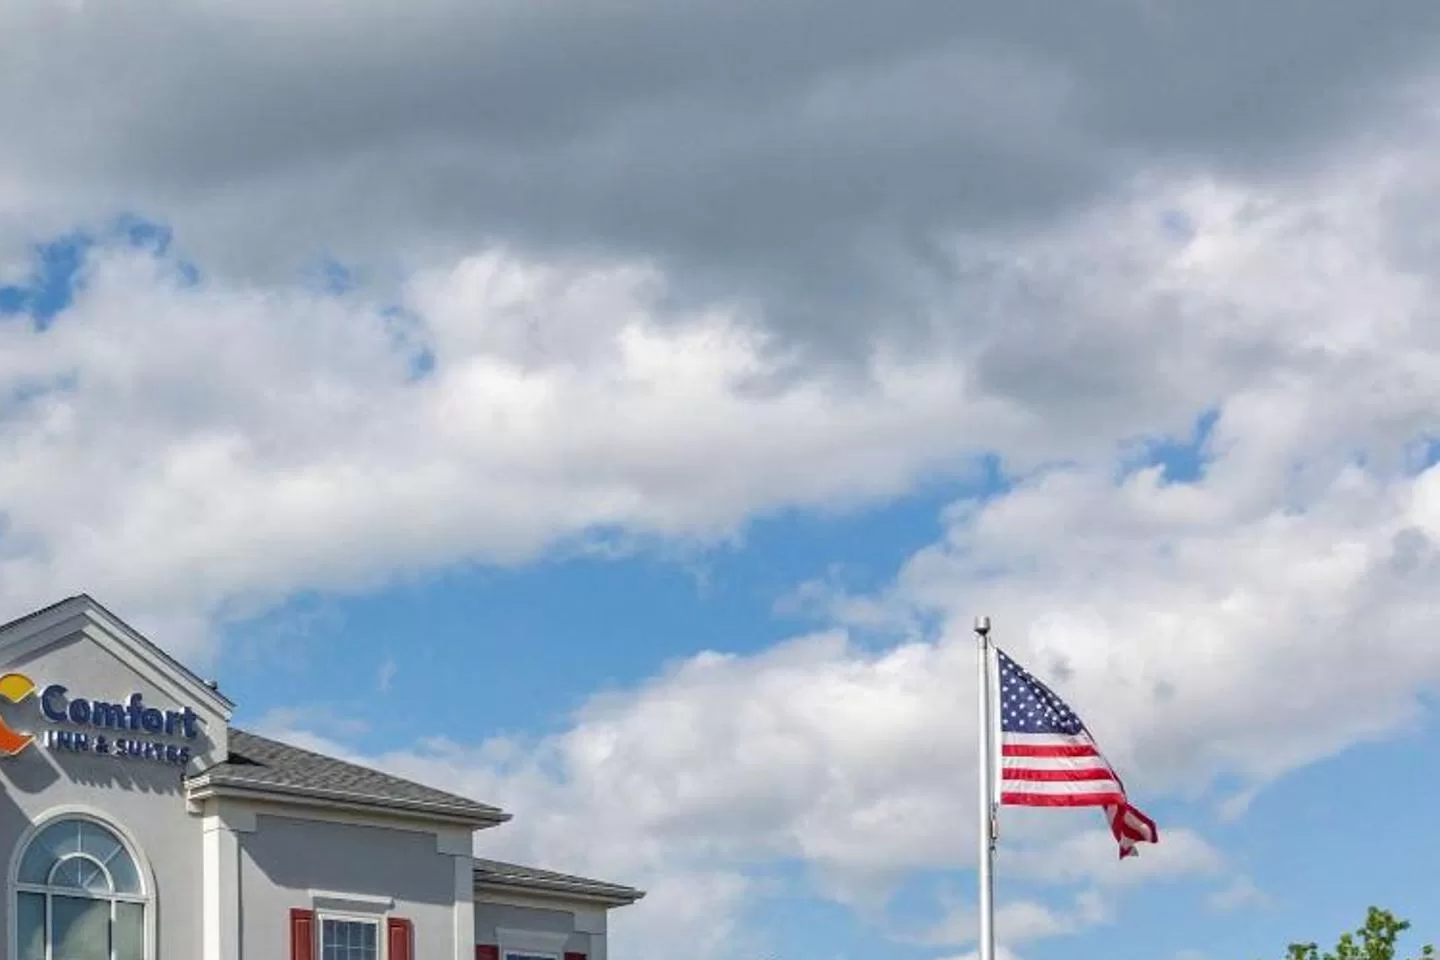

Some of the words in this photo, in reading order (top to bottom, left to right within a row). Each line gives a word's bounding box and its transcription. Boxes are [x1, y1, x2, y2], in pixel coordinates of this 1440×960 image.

[40, 684, 198, 739] Comfort
[43, 731, 89, 752] INN
[92, 735, 109, 753] &
[111, 739, 190, 765] SUITES
